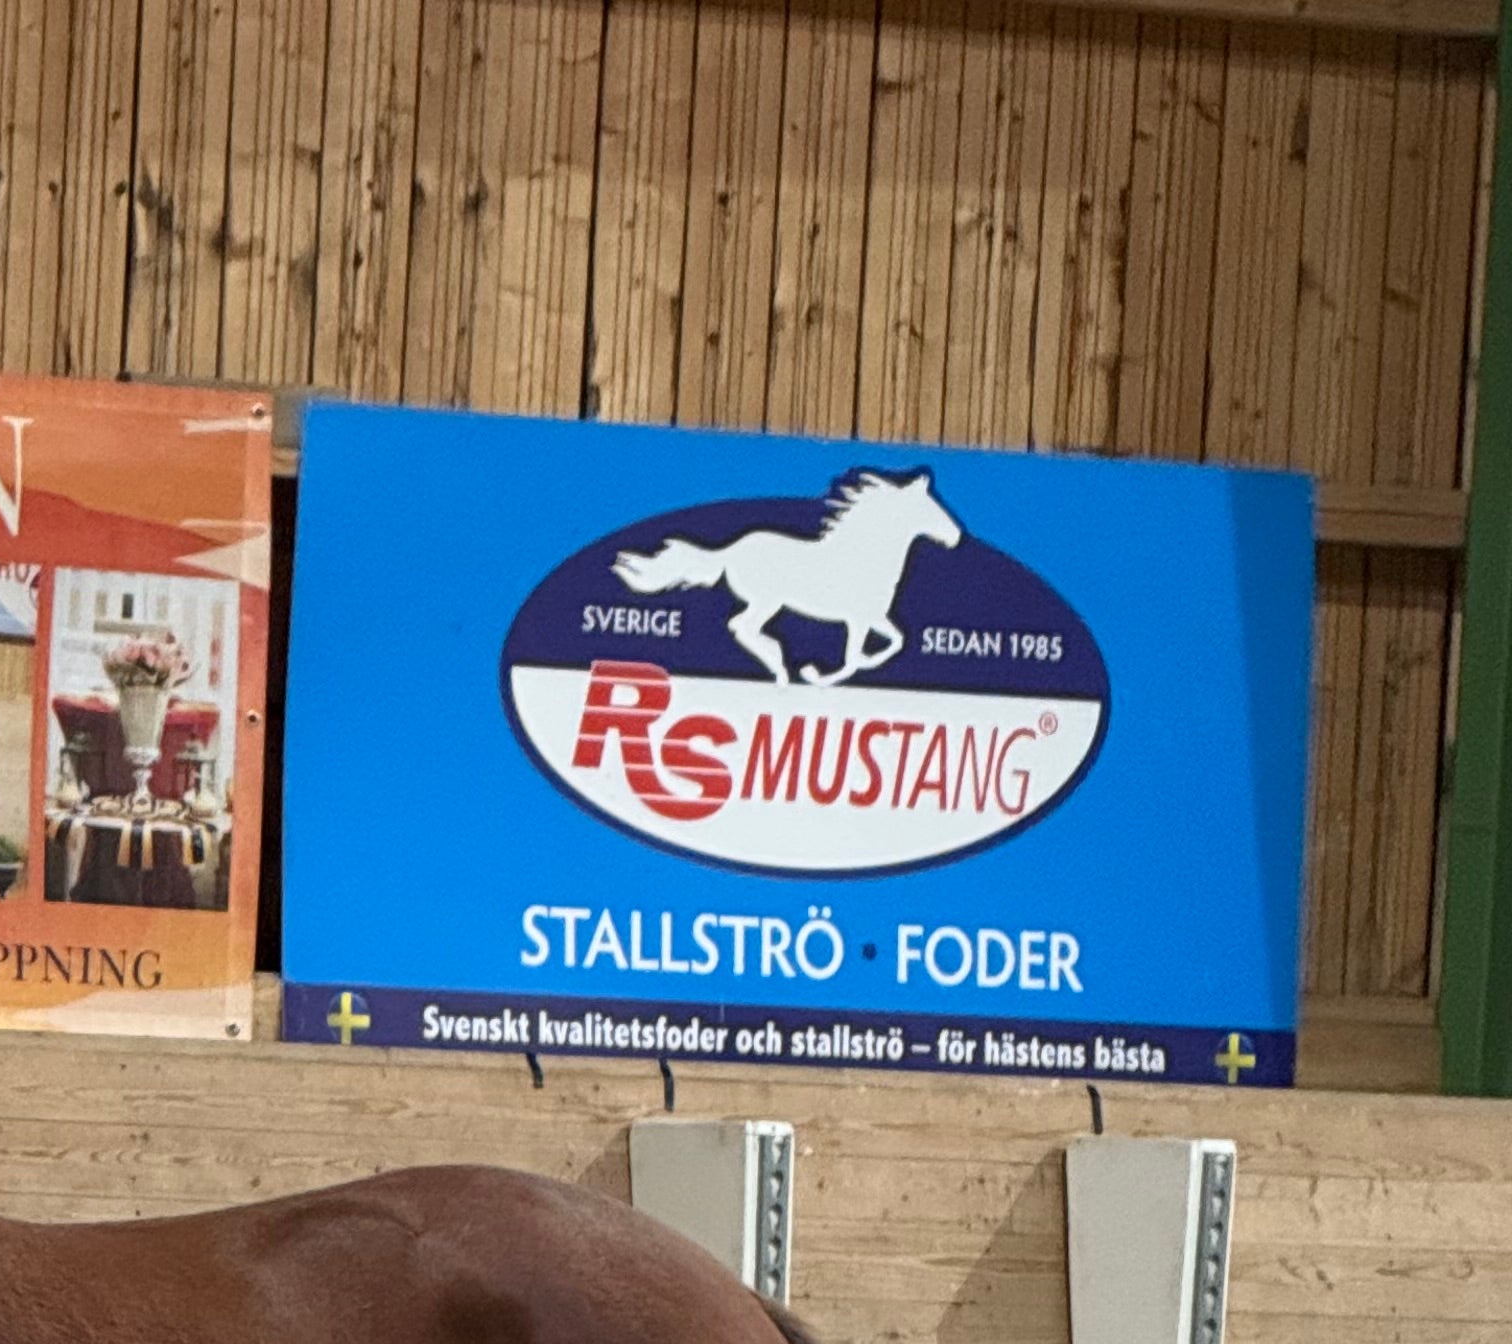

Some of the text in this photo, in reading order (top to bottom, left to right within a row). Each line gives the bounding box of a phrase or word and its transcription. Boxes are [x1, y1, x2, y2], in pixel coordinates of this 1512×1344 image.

[582, 605, 681, 637] SVERIGE
[921, 627, 1063, 661] SEDAN 1985
[520, 904, 1083, 992] STALLSTRÖ FODER
[423, 1004, 530, 1043] Svenskt
[539, 1009, 728, 1053] kvalitetsfoder
[735, 1021, 783, 1055] och
[791, 1023, 903, 1061] stallströ
[937, 1029, 977, 1064] för
[985, 1031, 1086, 1069] hästens
[1094, 1035, 1166, 1073] bästa
